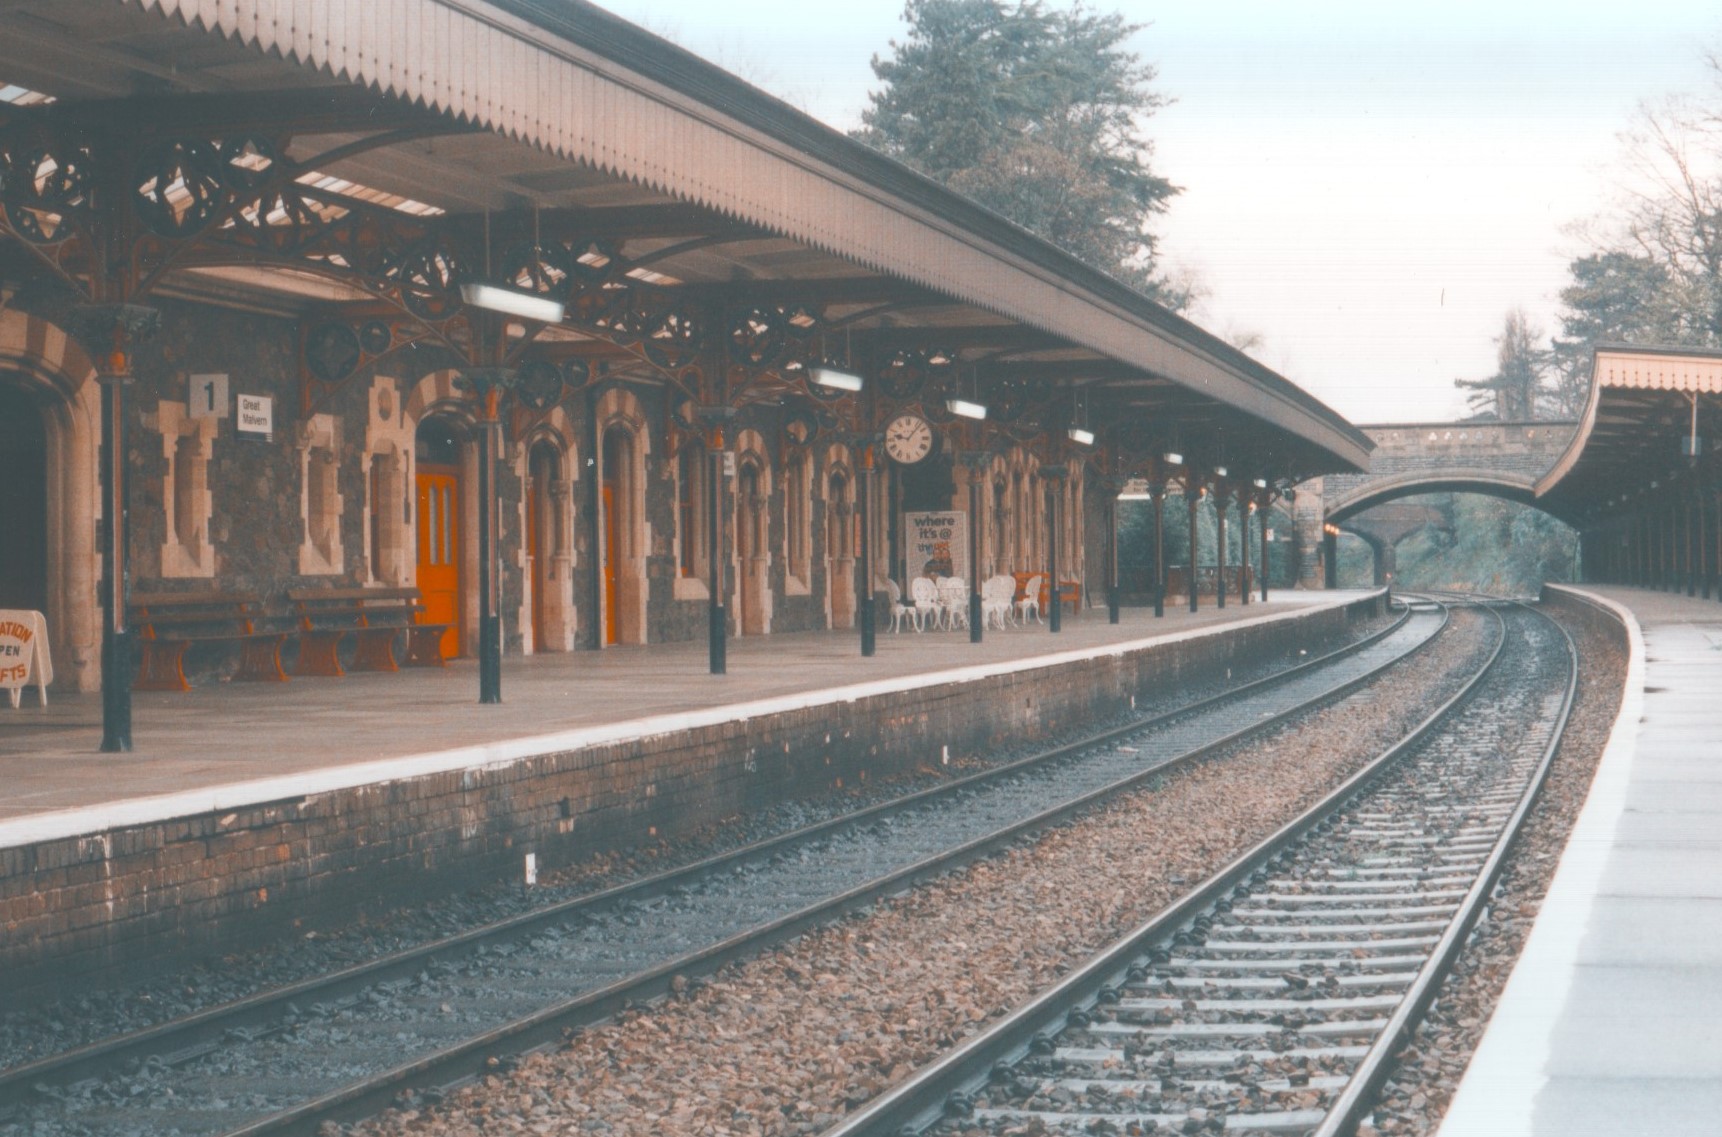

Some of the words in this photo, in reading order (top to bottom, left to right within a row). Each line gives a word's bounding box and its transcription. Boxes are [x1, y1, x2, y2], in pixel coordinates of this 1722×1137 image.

[204, 382, 214, 411] 1
[242, 399, 261, 411] Great
[242, 414, 268, 426] Malvern
[914, 515, 955, 527] where
[919, 528, 937, 539] it's
